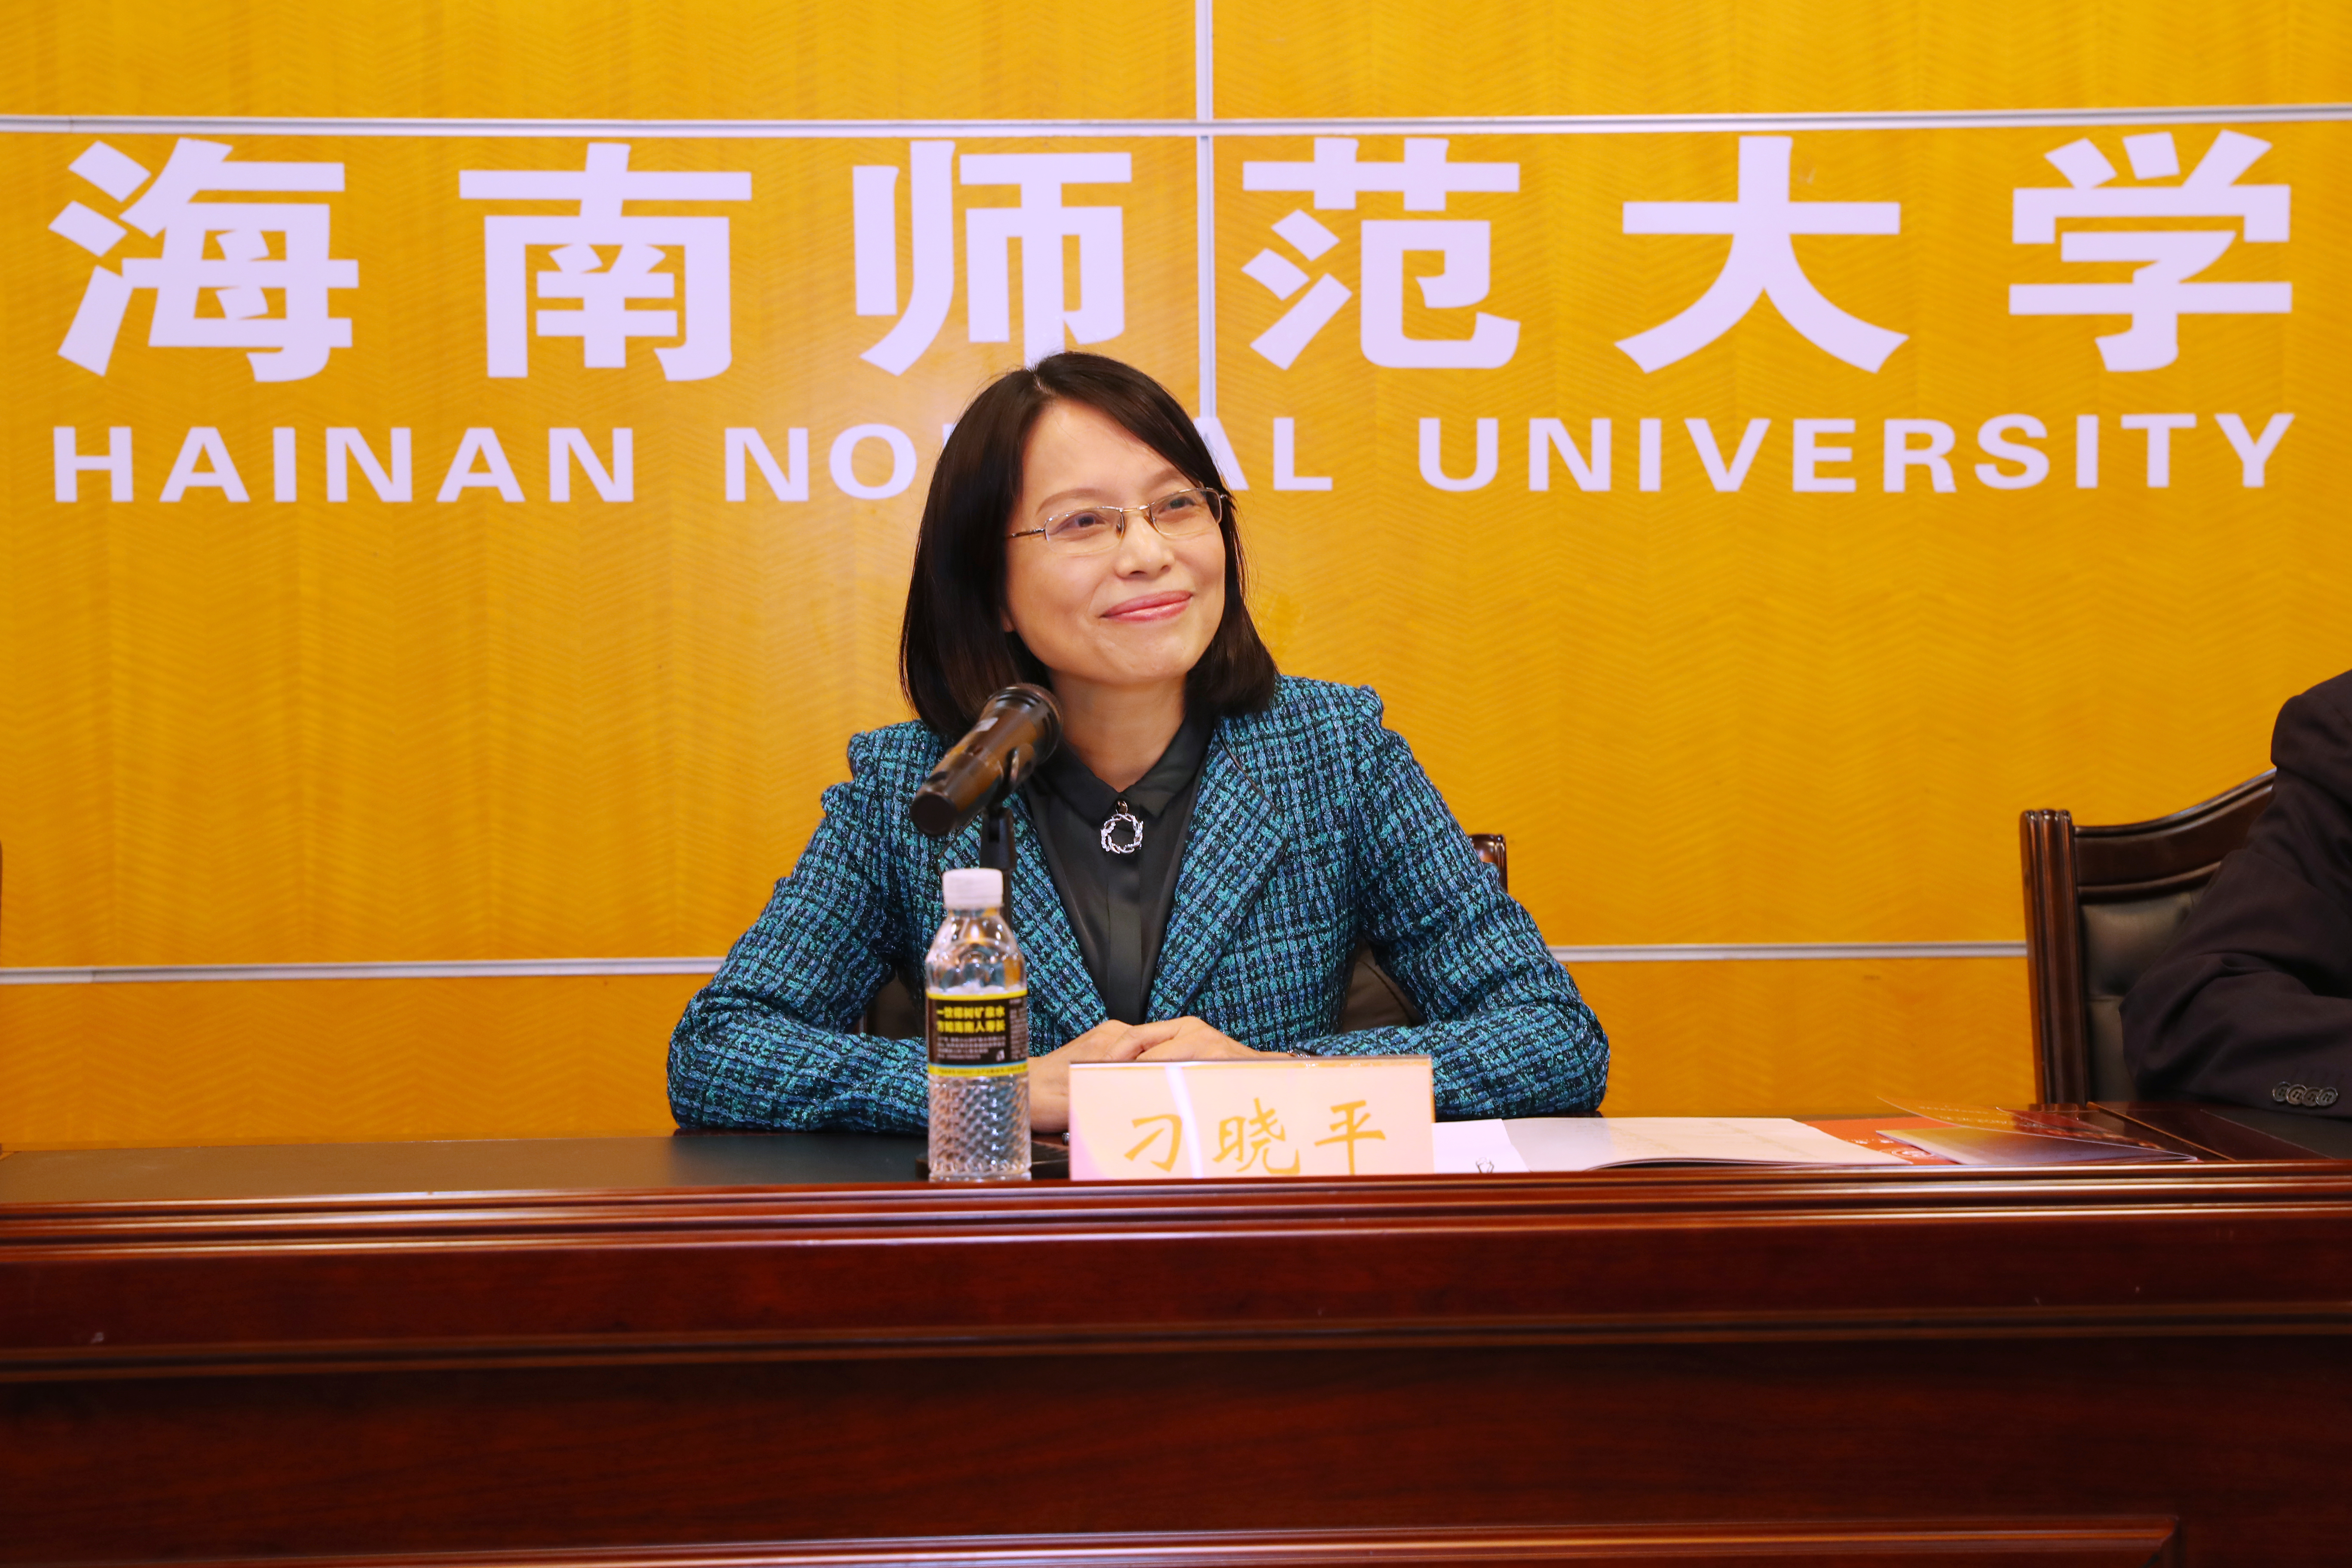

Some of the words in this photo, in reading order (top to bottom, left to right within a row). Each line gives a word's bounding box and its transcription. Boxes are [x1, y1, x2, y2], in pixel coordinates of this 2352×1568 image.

[49, 131, 2293, 382] 海南师范大学
[54, 427, 634, 502] HAINAN
[725, 417, 1332, 502] NOAL
[1419, 413, 2294, 493] UNIVERSITY
[1124, 1098, 1386, 1176] 刁晓平
